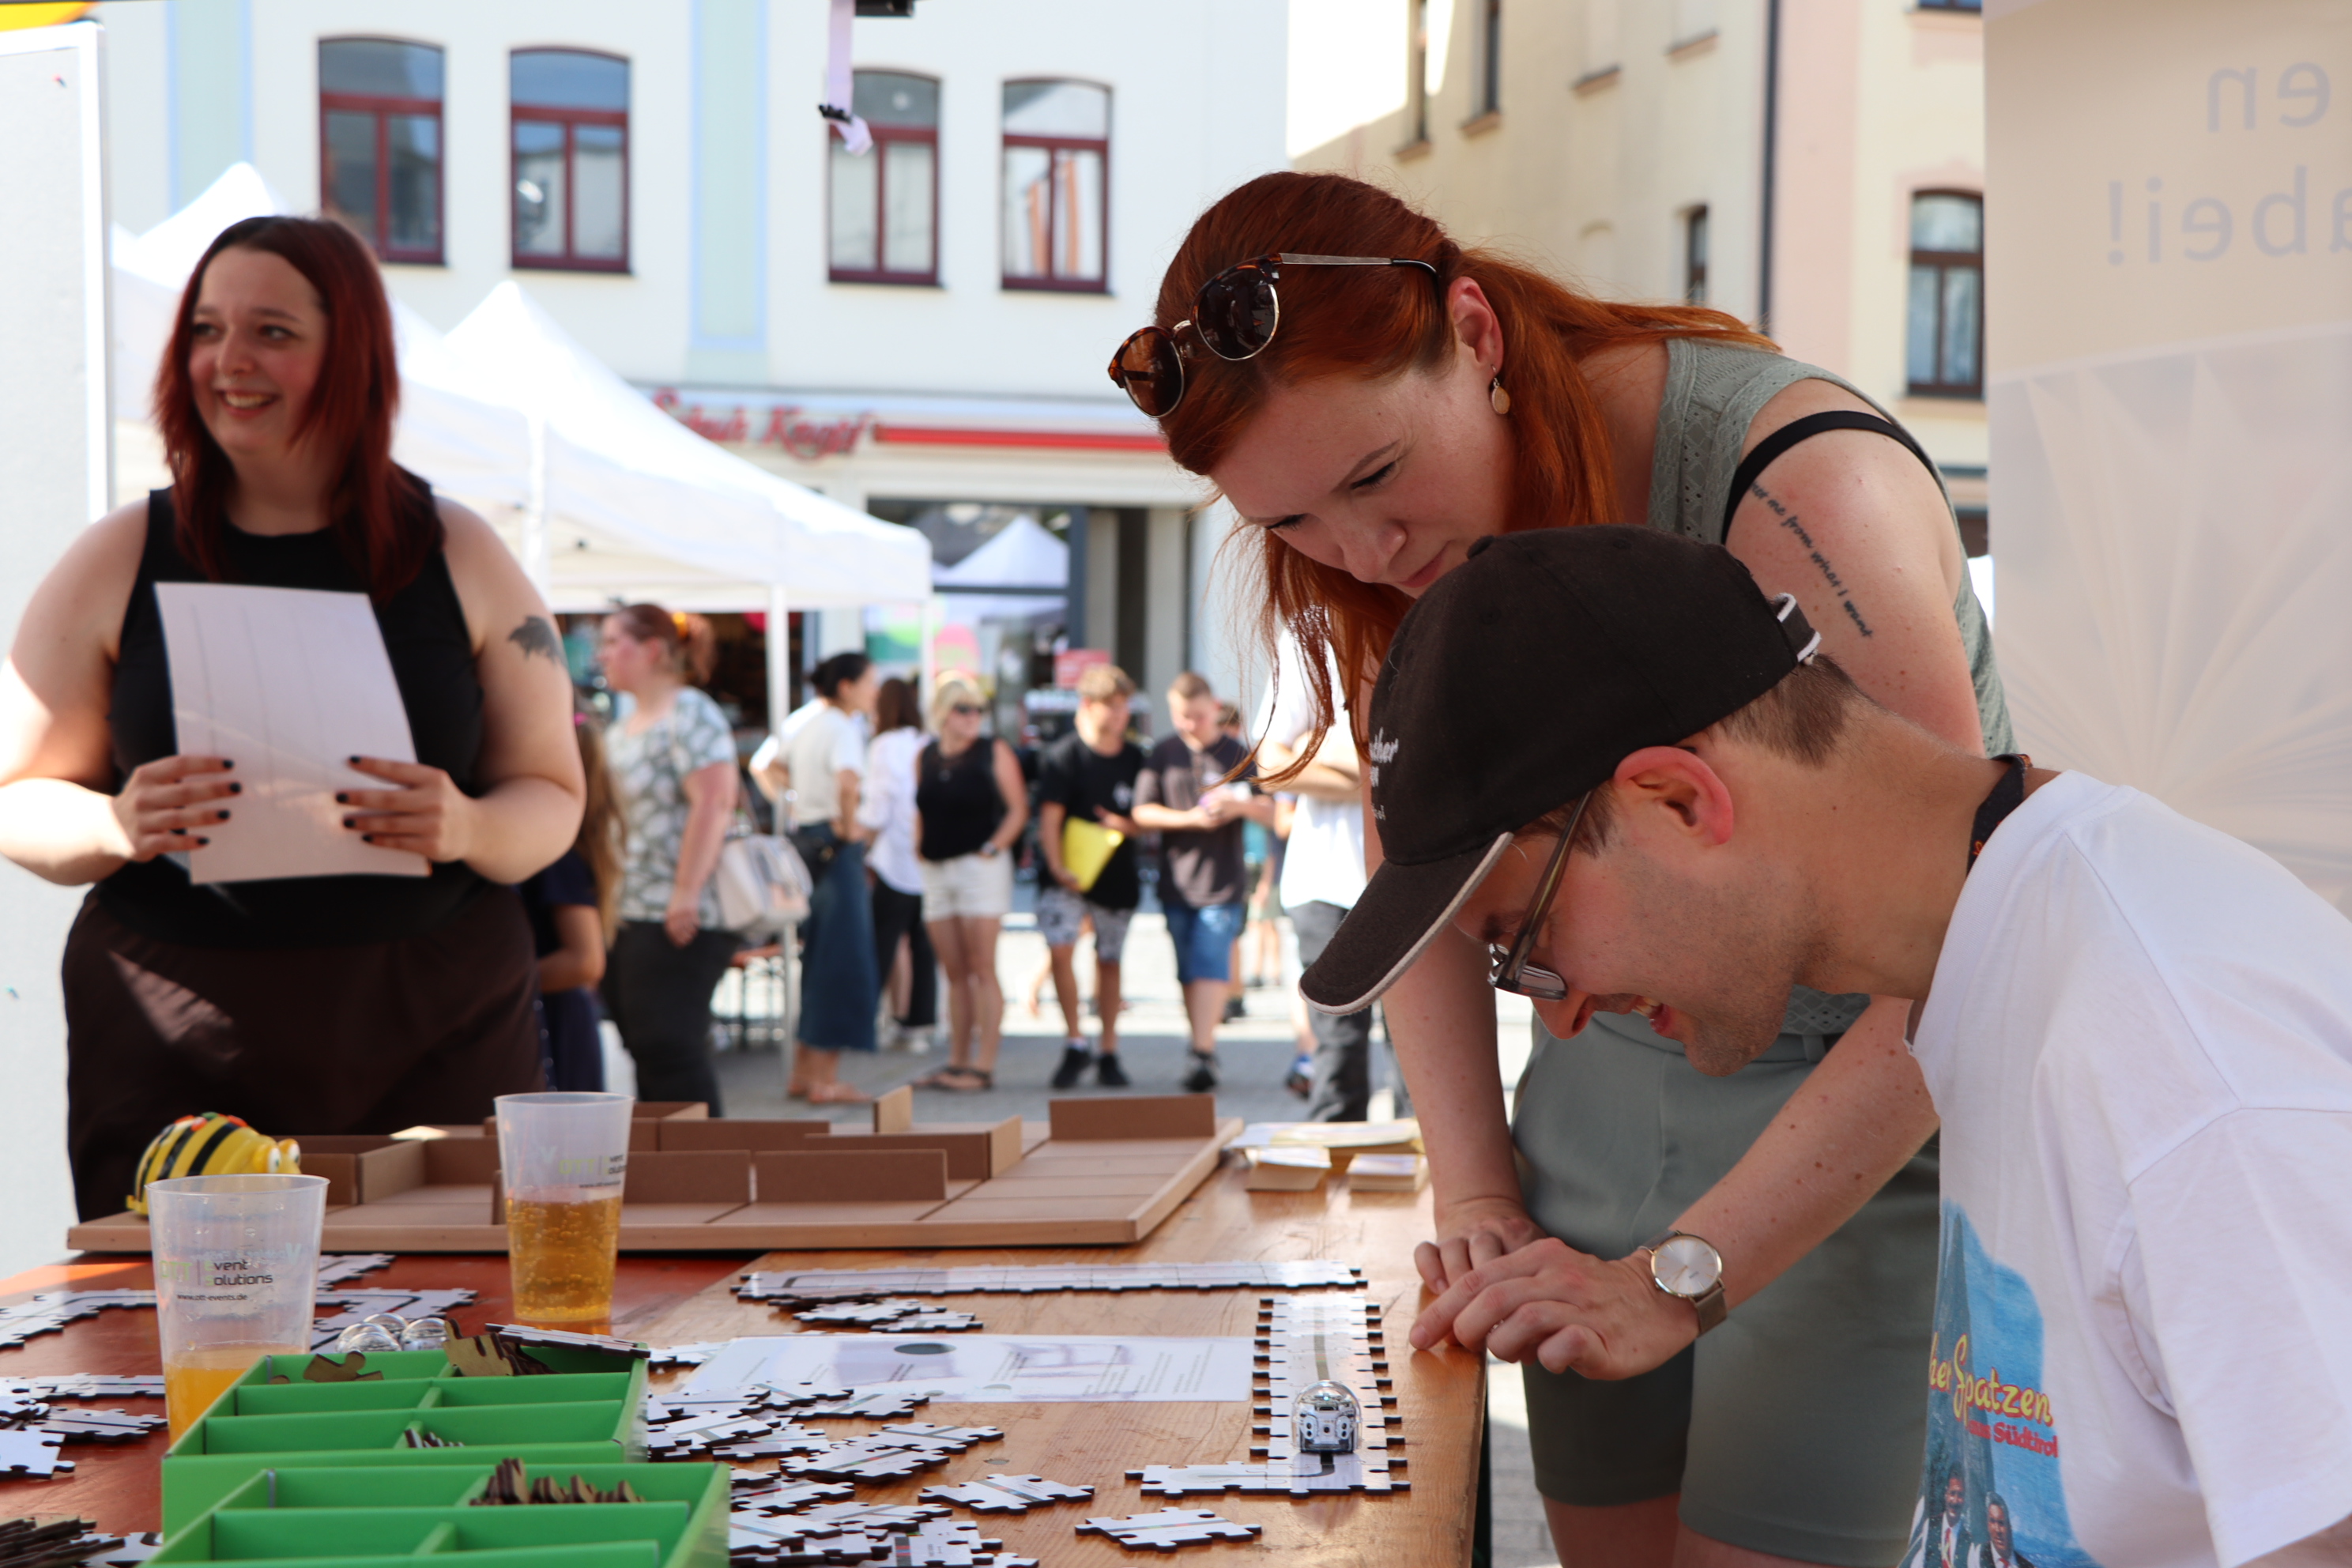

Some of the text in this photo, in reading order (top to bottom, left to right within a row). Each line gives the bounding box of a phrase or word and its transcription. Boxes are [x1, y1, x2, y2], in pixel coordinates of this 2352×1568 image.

[1767, 499, 1786, 516] me
[1780, 515, 1814, 548] from
[1811, 552, 1842, 587] what
[1844, 600, 1873, 637] want
[1952, 1333, 2054, 1427] Spatzen
[1992, 1421, 2060, 1458] Südtirol
